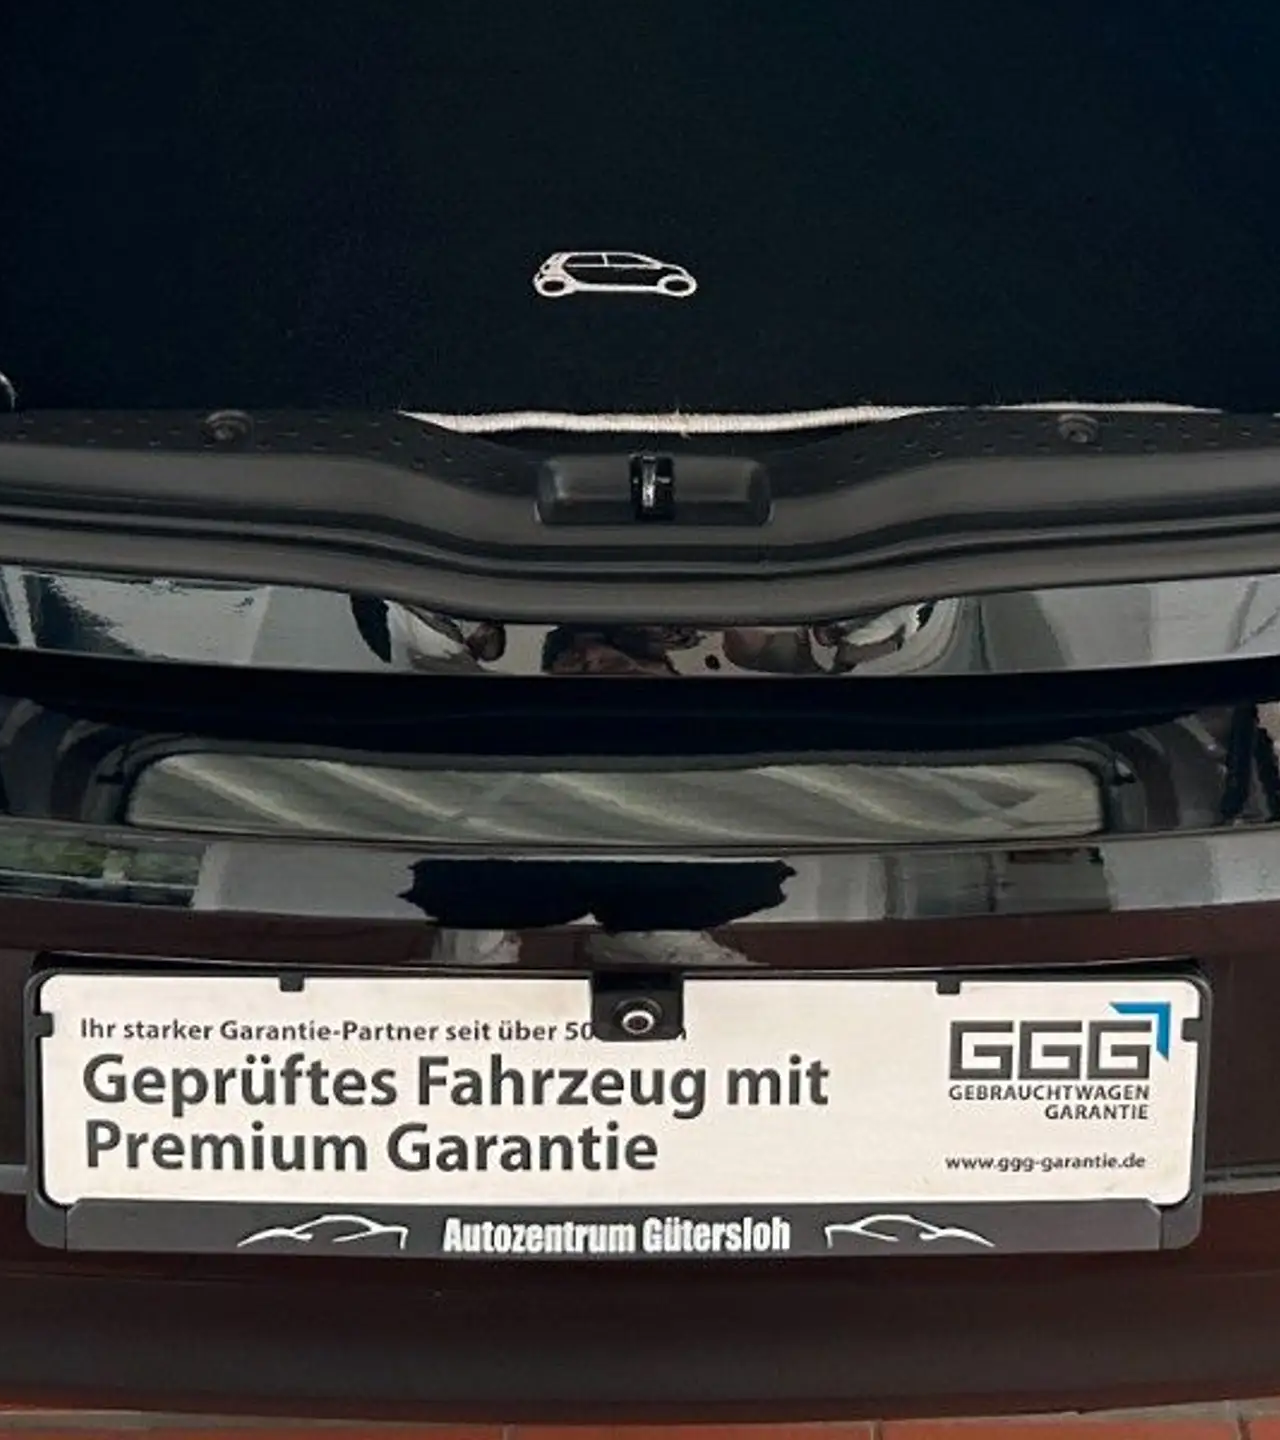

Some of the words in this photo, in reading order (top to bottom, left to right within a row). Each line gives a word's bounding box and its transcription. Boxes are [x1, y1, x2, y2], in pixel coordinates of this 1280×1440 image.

[81, 1018, 116, 1039] Ihr
[123, 1019, 214, 1040] starker
[220, 1020, 439, 1041] Garantie-Partner
[445, 1020, 492, 1041] seit
[498, 1020, 558, 1041] über
[949, 1020, 1152, 1081] GGG
[83, 1052, 398, 1118] Geprüftes
[417, 1053, 707, 1120] Fahrzeug
[726, 1053, 830, 1106] mit
[948, 1084, 1150, 1101] GEBRAUCHTWAGEN
[1044, 1103, 1149, 1120] GARANTIE
[86, 1119, 367, 1172] Premium
[387, 1119, 659, 1172] Garantie
[945, 1153, 1146, 1173] www.ggg-garantie.de
[443, 1217, 636, 1253] Autozentrum
[642, 1216, 791, 1253] Gütersloh
